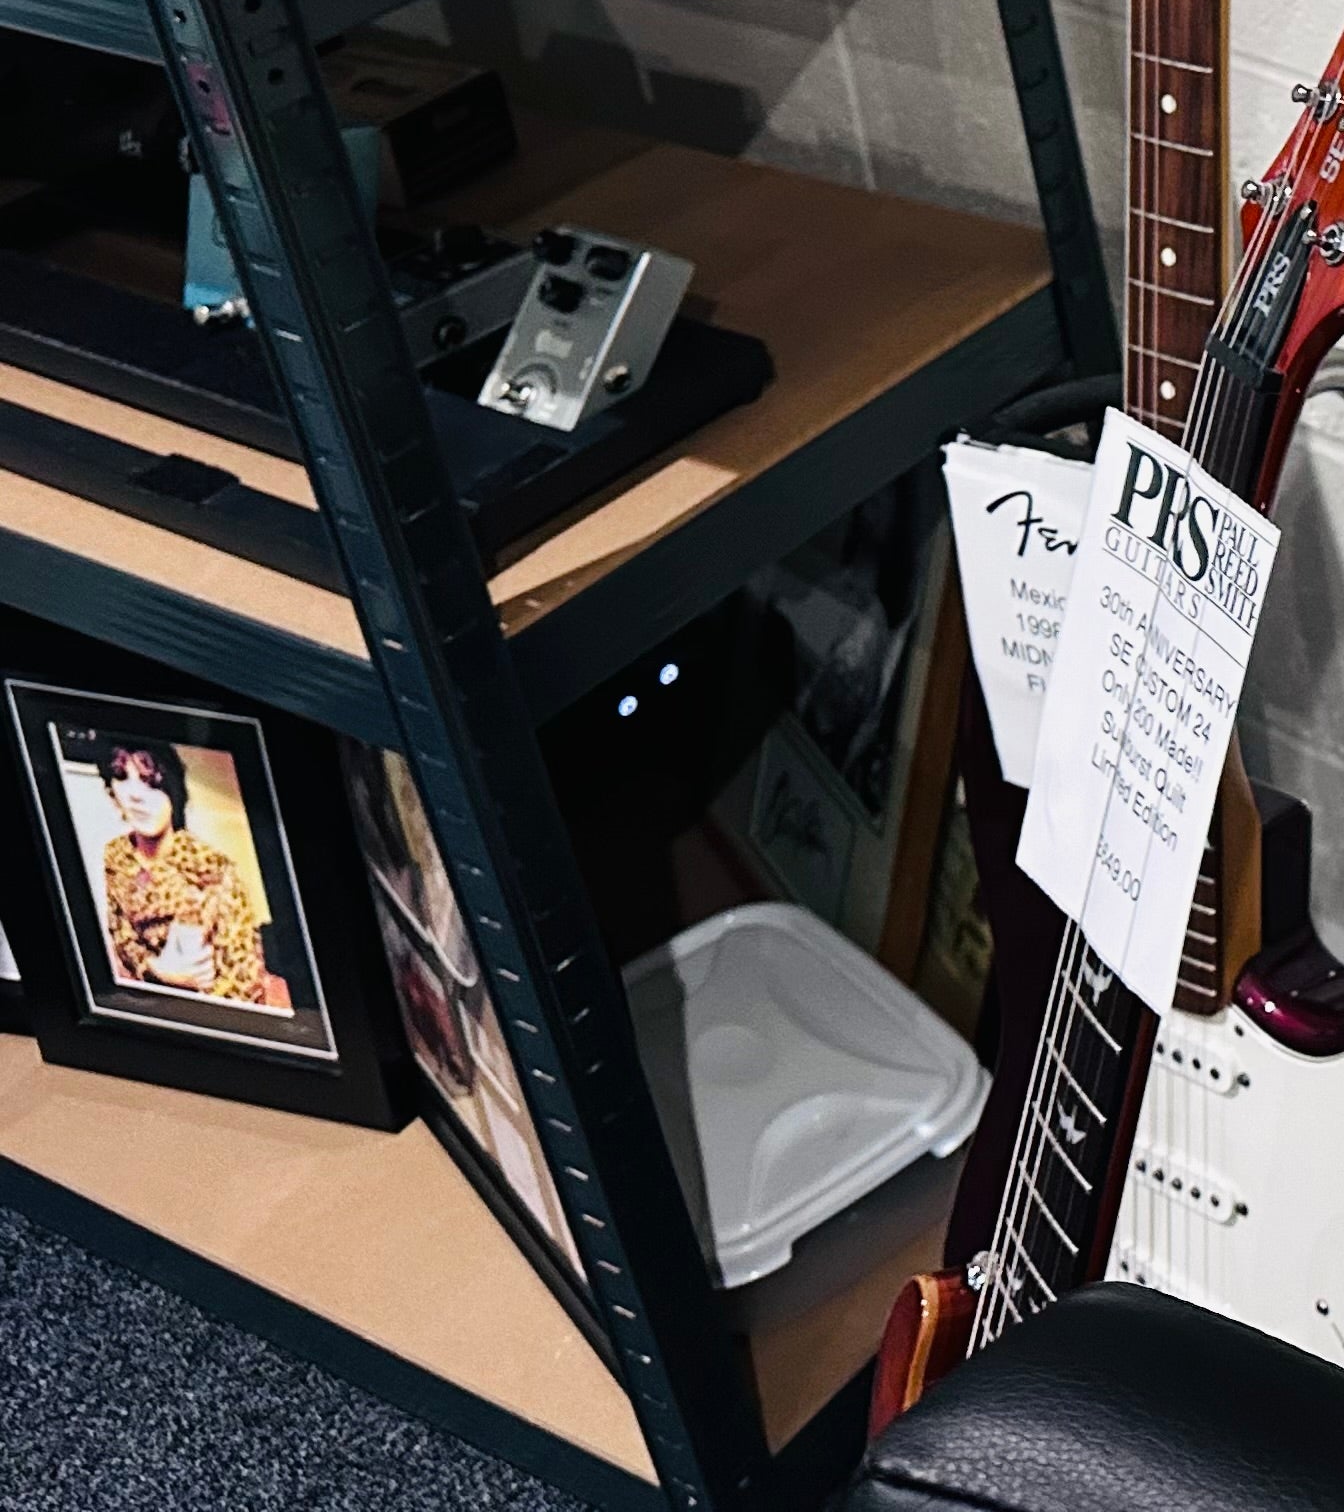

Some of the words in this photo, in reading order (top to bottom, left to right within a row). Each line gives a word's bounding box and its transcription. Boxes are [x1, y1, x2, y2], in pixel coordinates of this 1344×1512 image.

[1254, 252, 1290, 317] PRS
[1110, 442, 1219, 581] PRS
[1219, 512, 1259, 567] PAUL
[1105, 526, 1201, 619] GUITARS
[1212, 540, 1258, 596] REED
[1110, 633, 1134, 666] SE
[1136, 654, 1192, 727] CUSTOM
[1193, 713, 1211, 744] 24
[1091, 742, 1131, 804] Limed
